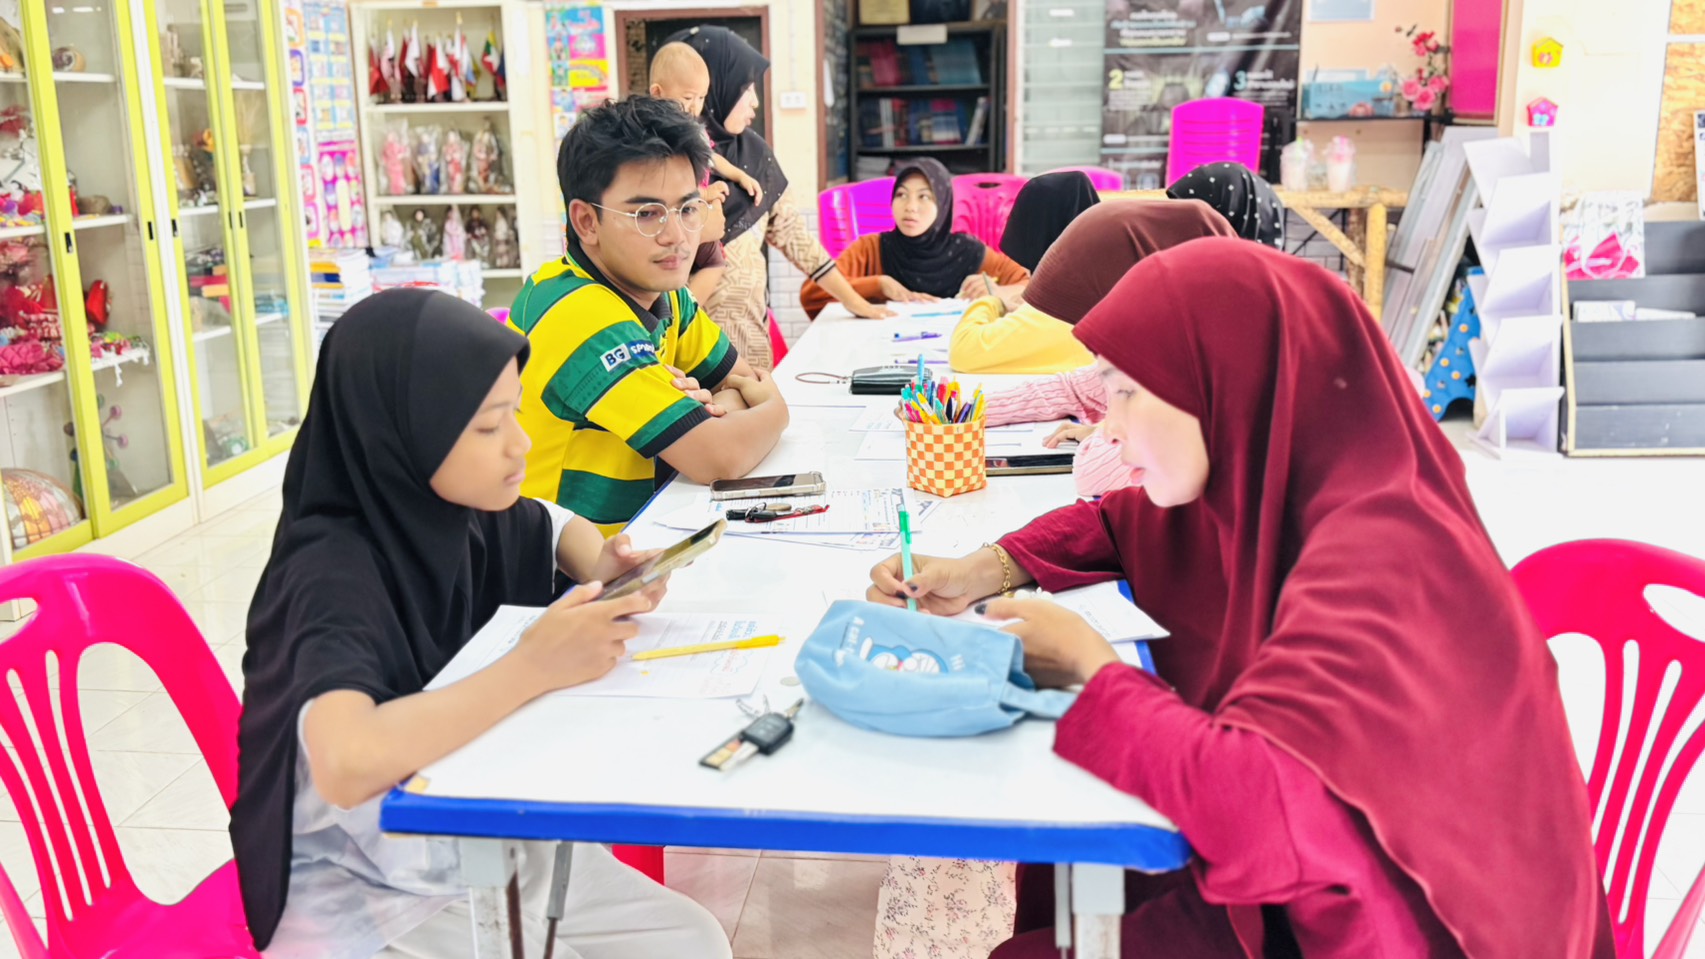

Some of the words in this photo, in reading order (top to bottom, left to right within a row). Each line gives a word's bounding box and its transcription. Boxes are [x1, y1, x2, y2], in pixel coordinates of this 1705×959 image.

[1109, 69, 1123, 89] 2
[1234, 70, 1247, 90] 3
[605, 348, 626, 366] BG
